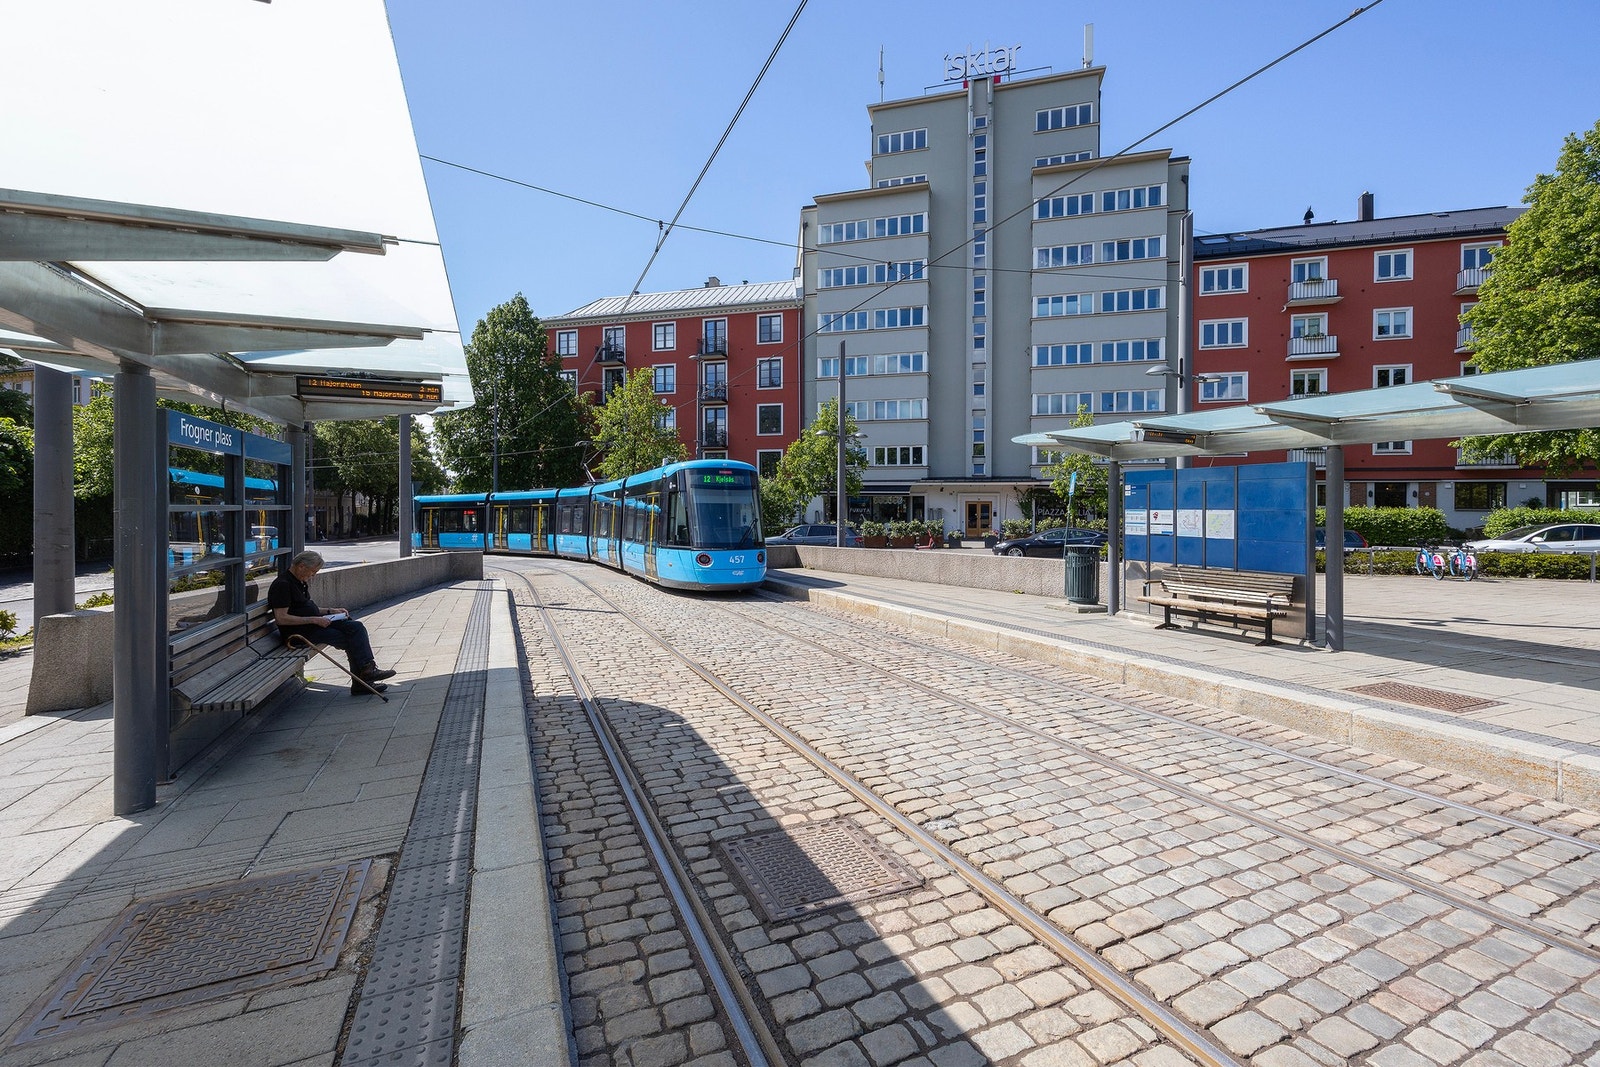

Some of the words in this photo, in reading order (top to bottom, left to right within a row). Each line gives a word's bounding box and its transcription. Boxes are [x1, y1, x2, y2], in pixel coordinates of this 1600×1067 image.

[320, 379, 362, 388] Majorstuen
[373, 390, 413, 399] Majorstuen
[180, 418, 213, 444] Frogner
[215, 427, 233, 447] plass
[703, 475, 711, 483] 12
[1037, 508, 1065, 516] PIAZZA
[729, 555, 745, 564] 457
